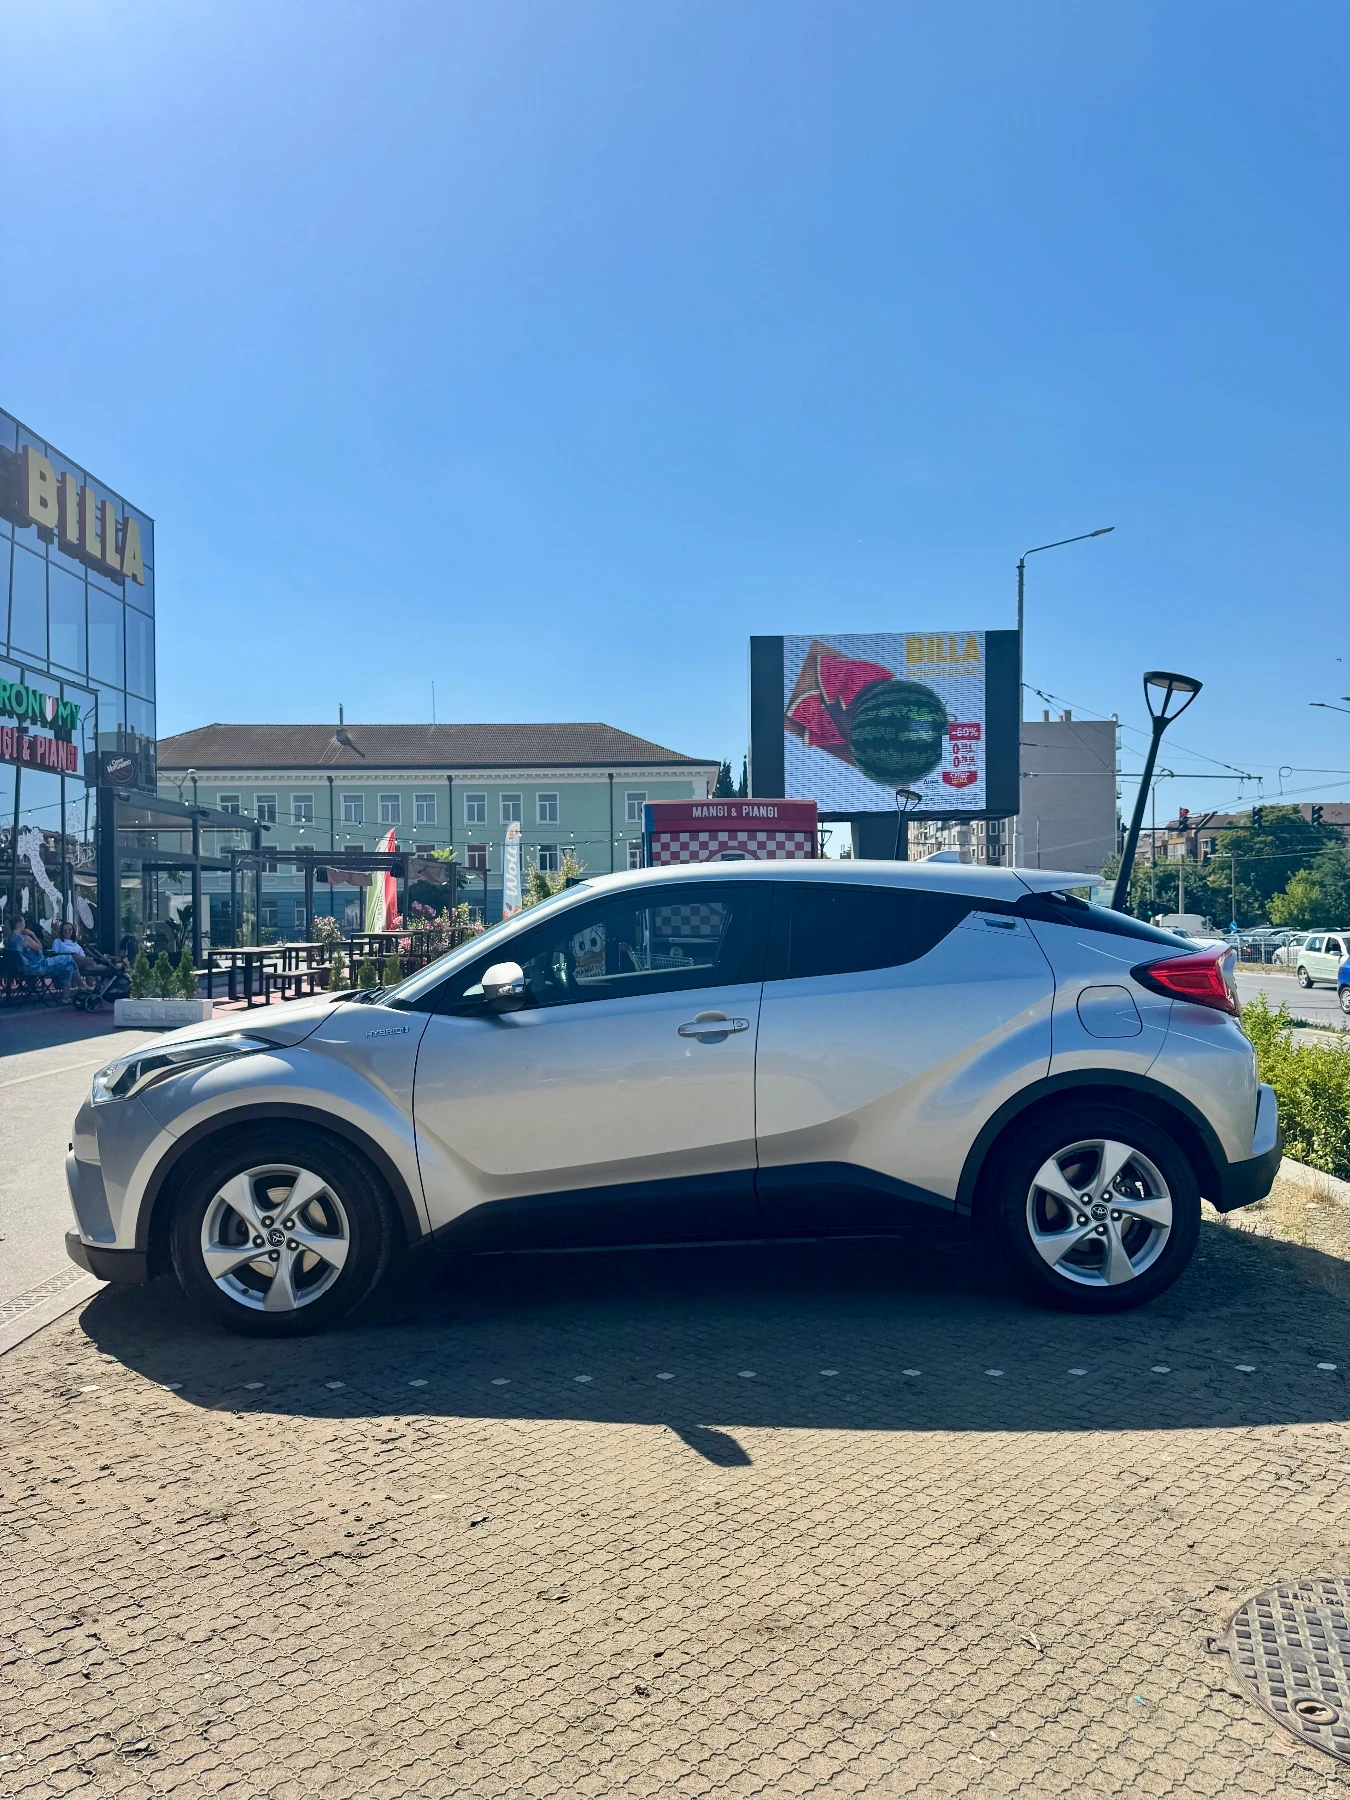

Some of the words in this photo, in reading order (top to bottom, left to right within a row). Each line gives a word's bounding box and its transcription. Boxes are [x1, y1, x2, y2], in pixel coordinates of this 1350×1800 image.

[23, 445, 146, 586] BILLA
[905, 635, 981, 664] BILLA
[949, 727, 979, 737] -60%
[22, 738, 31, 760] &
[34, 735, 78, 772] PIANGI
[692, 806, 728, 818] MANGI
[731, 808, 737, 817] &
[742, 806, 778, 818] PIANGI
[505, 844, 518, 896] Wolt
[365, 1027, 402, 1038] HYBRID
